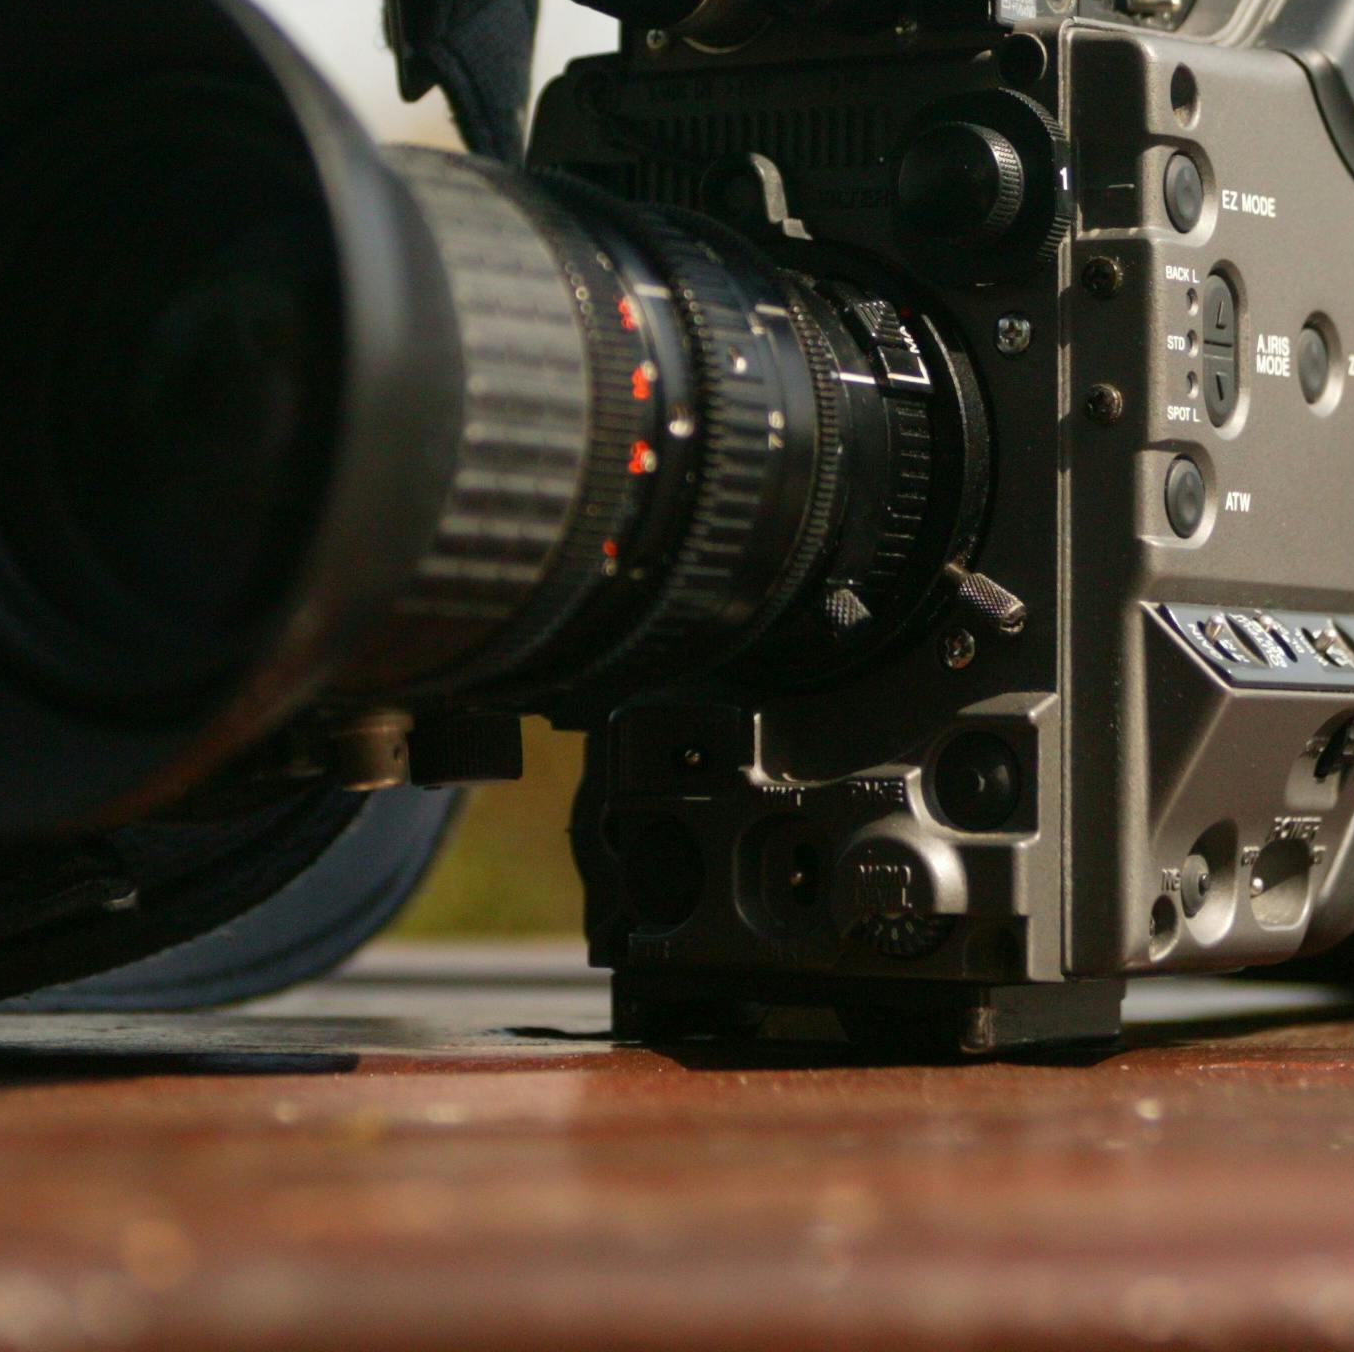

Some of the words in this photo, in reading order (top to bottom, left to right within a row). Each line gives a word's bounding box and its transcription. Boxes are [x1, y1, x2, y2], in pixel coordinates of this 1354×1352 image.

[1059, 166, 1068, 190] 1
[1221, 189, 1238, 211] EZ
[1241, 192, 1276, 218] MODE
[1165, 265, 1190, 283] BACK
[1166, 335, 1185, 351] STD
[1256, 334, 1291, 356] A.IRIS
[1256, 354, 1291, 377] MODE
[1166, 405, 1192, 422] SPOT
[1225, 491, 1251, 513] ATW
